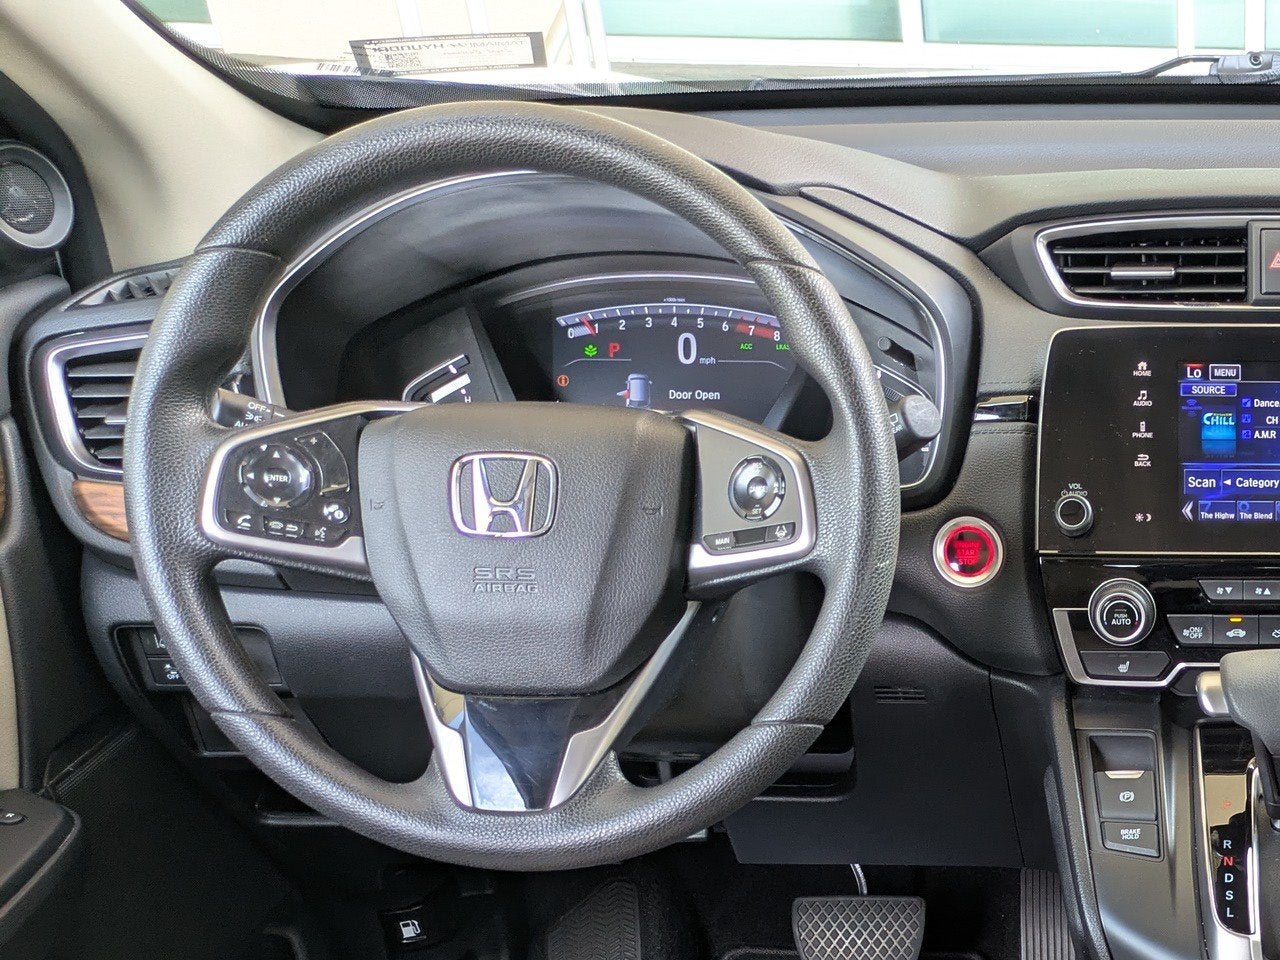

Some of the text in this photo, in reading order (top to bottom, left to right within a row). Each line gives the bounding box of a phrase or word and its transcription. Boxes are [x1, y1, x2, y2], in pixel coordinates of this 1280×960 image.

[619, 320, 626, 330] 2
[645, 317, 653, 328] 3
[671, 317, 678, 327] 4
[697, 318, 704, 328] 5
[722, 321, 729, 331] 6
[748, 325, 755, 336] 7
[774, 331, 781, 341] 8
[608, 342, 620, 358] P
[677, 332, 716, 366] 0 mph
[1187, 366, 1202, 379] Lo
[1214, 367, 1237, 378] MENU
[668, 389, 721, 401] Door Open
[1191, 385, 1226, 395] SOURCE
[1266, 416, 1279, 425] CH
[1187, 476, 1216, 488] Scan
[1235, 477, 1280, 489] Category
[1200, 511, 1212, 520] The
[1239, 511, 1273, 520] The Blend
[474, 566, 536, 581] SRS
[474, 582, 540, 594] AIRBAG
[1111, 618, 1132, 626] AUTO
[1223, 839, 1232, 849] R
[1223, 856, 1233, 866] N
[1224, 873, 1234, 883] D
[1225, 890, 1234, 900] S
[1226, 907, 1235, 918] L
